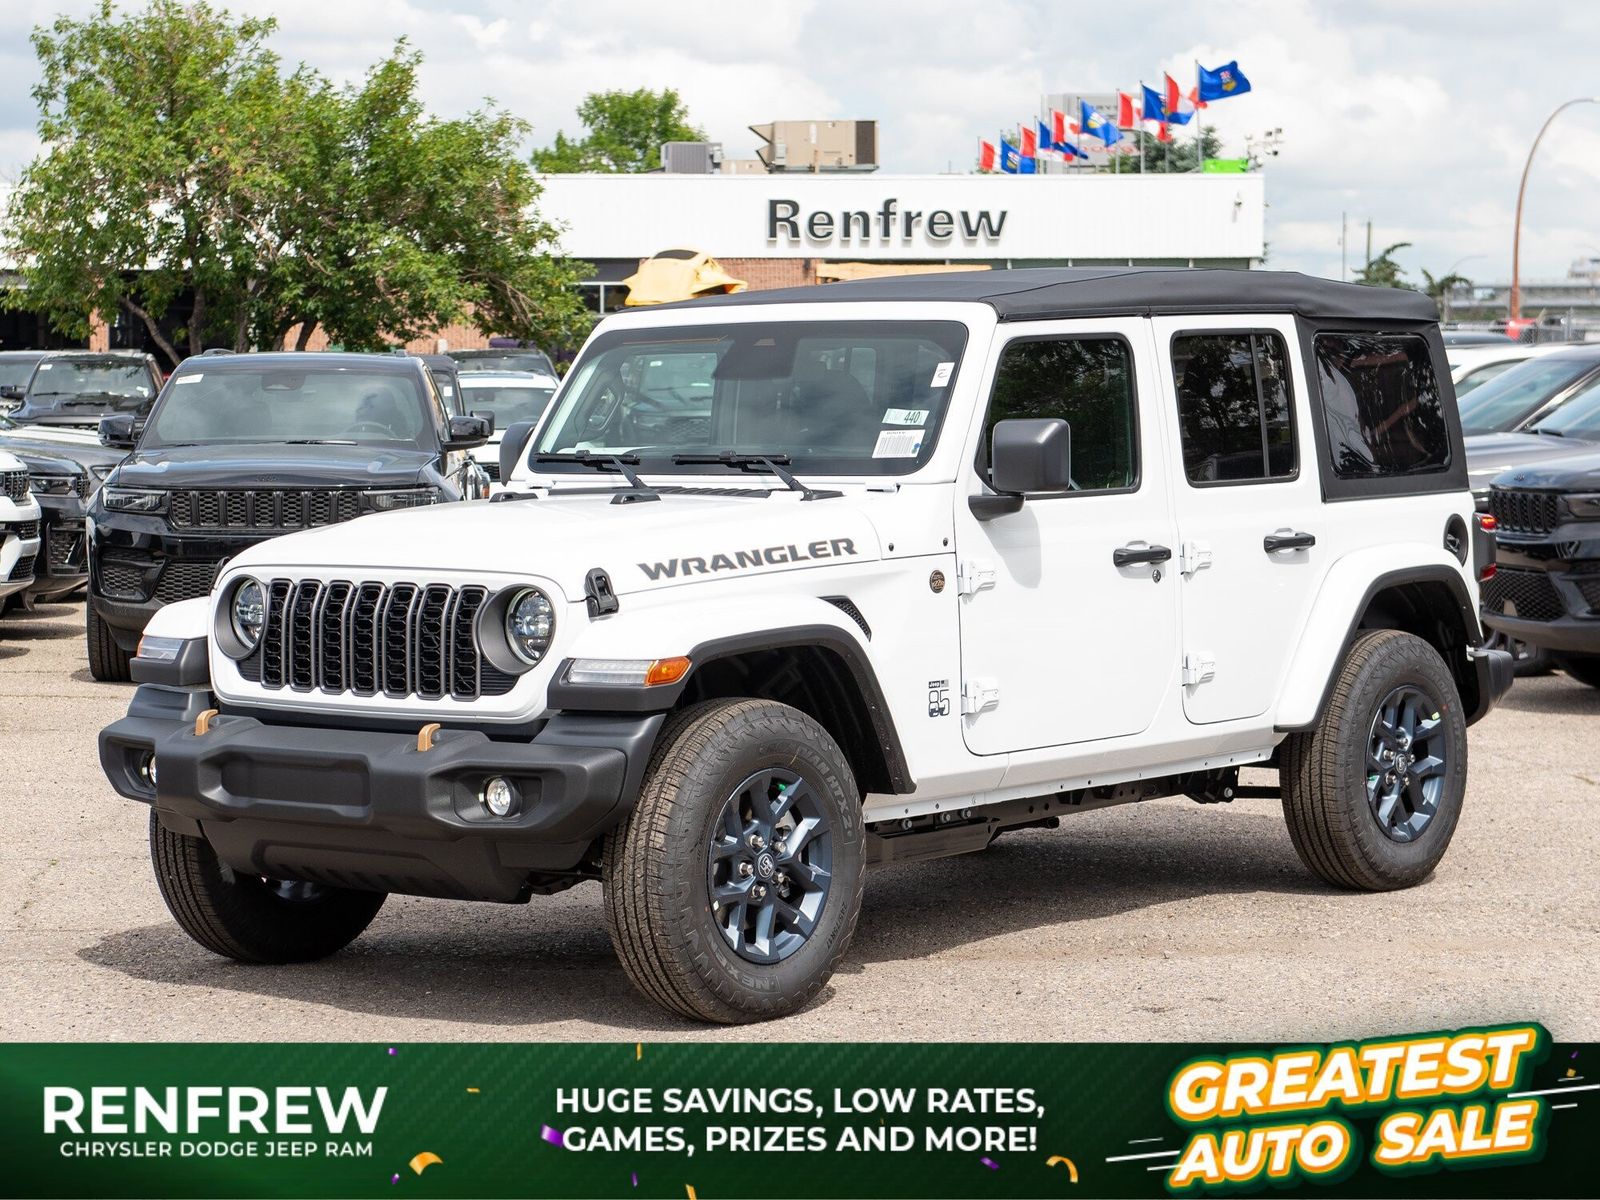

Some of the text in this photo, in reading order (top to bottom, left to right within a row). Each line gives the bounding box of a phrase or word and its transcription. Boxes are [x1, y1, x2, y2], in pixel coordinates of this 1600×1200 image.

[766, 198, 1008, 241] Renfrew
[903, 410, 921, 424] 440
[637, 537, 858, 581] WRANGLER
[928, 689, 951, 718] 85
